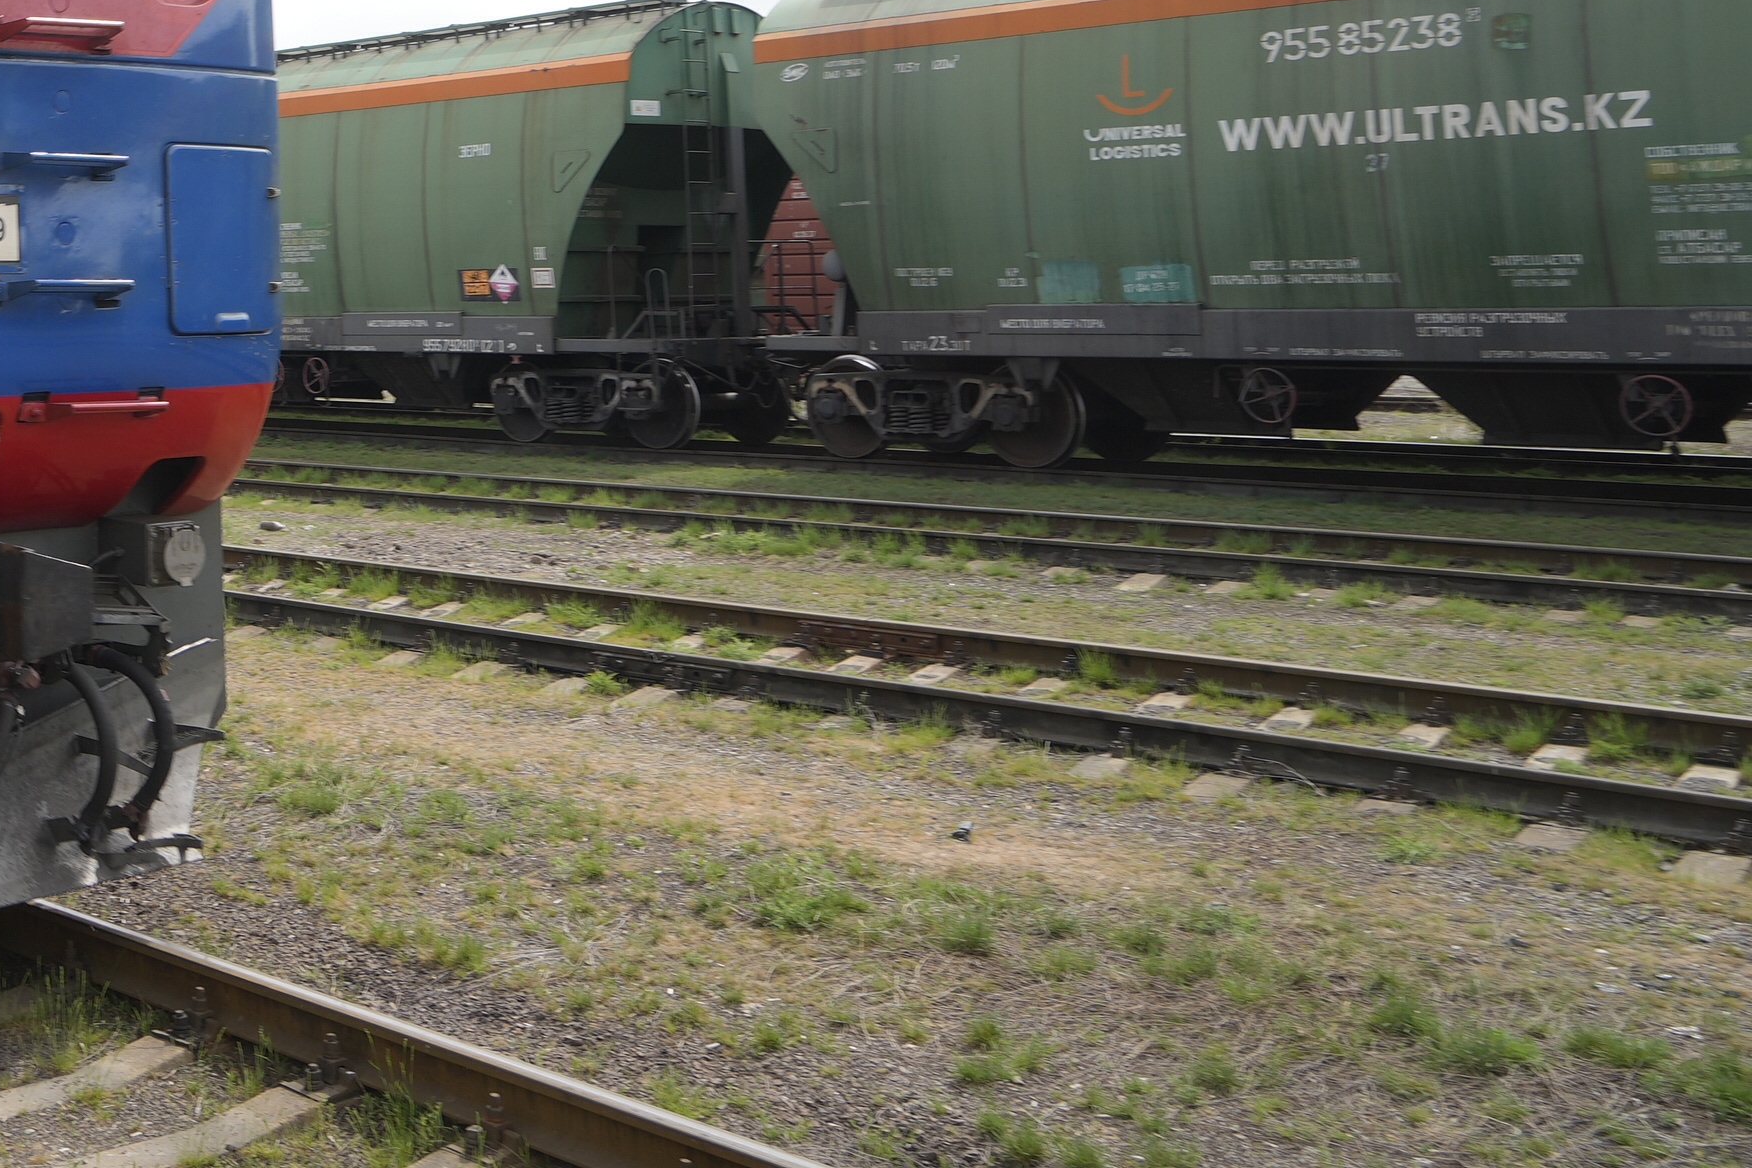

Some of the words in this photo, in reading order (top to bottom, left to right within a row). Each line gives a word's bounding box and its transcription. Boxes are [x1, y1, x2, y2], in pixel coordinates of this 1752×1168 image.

[1217, 90, 1653, 152] WWW.ULTRANS.KZ
[1083, 124, 1186, 142] UNIVERSAL
[1090, 143, 1181, 160] LOGISTICS
